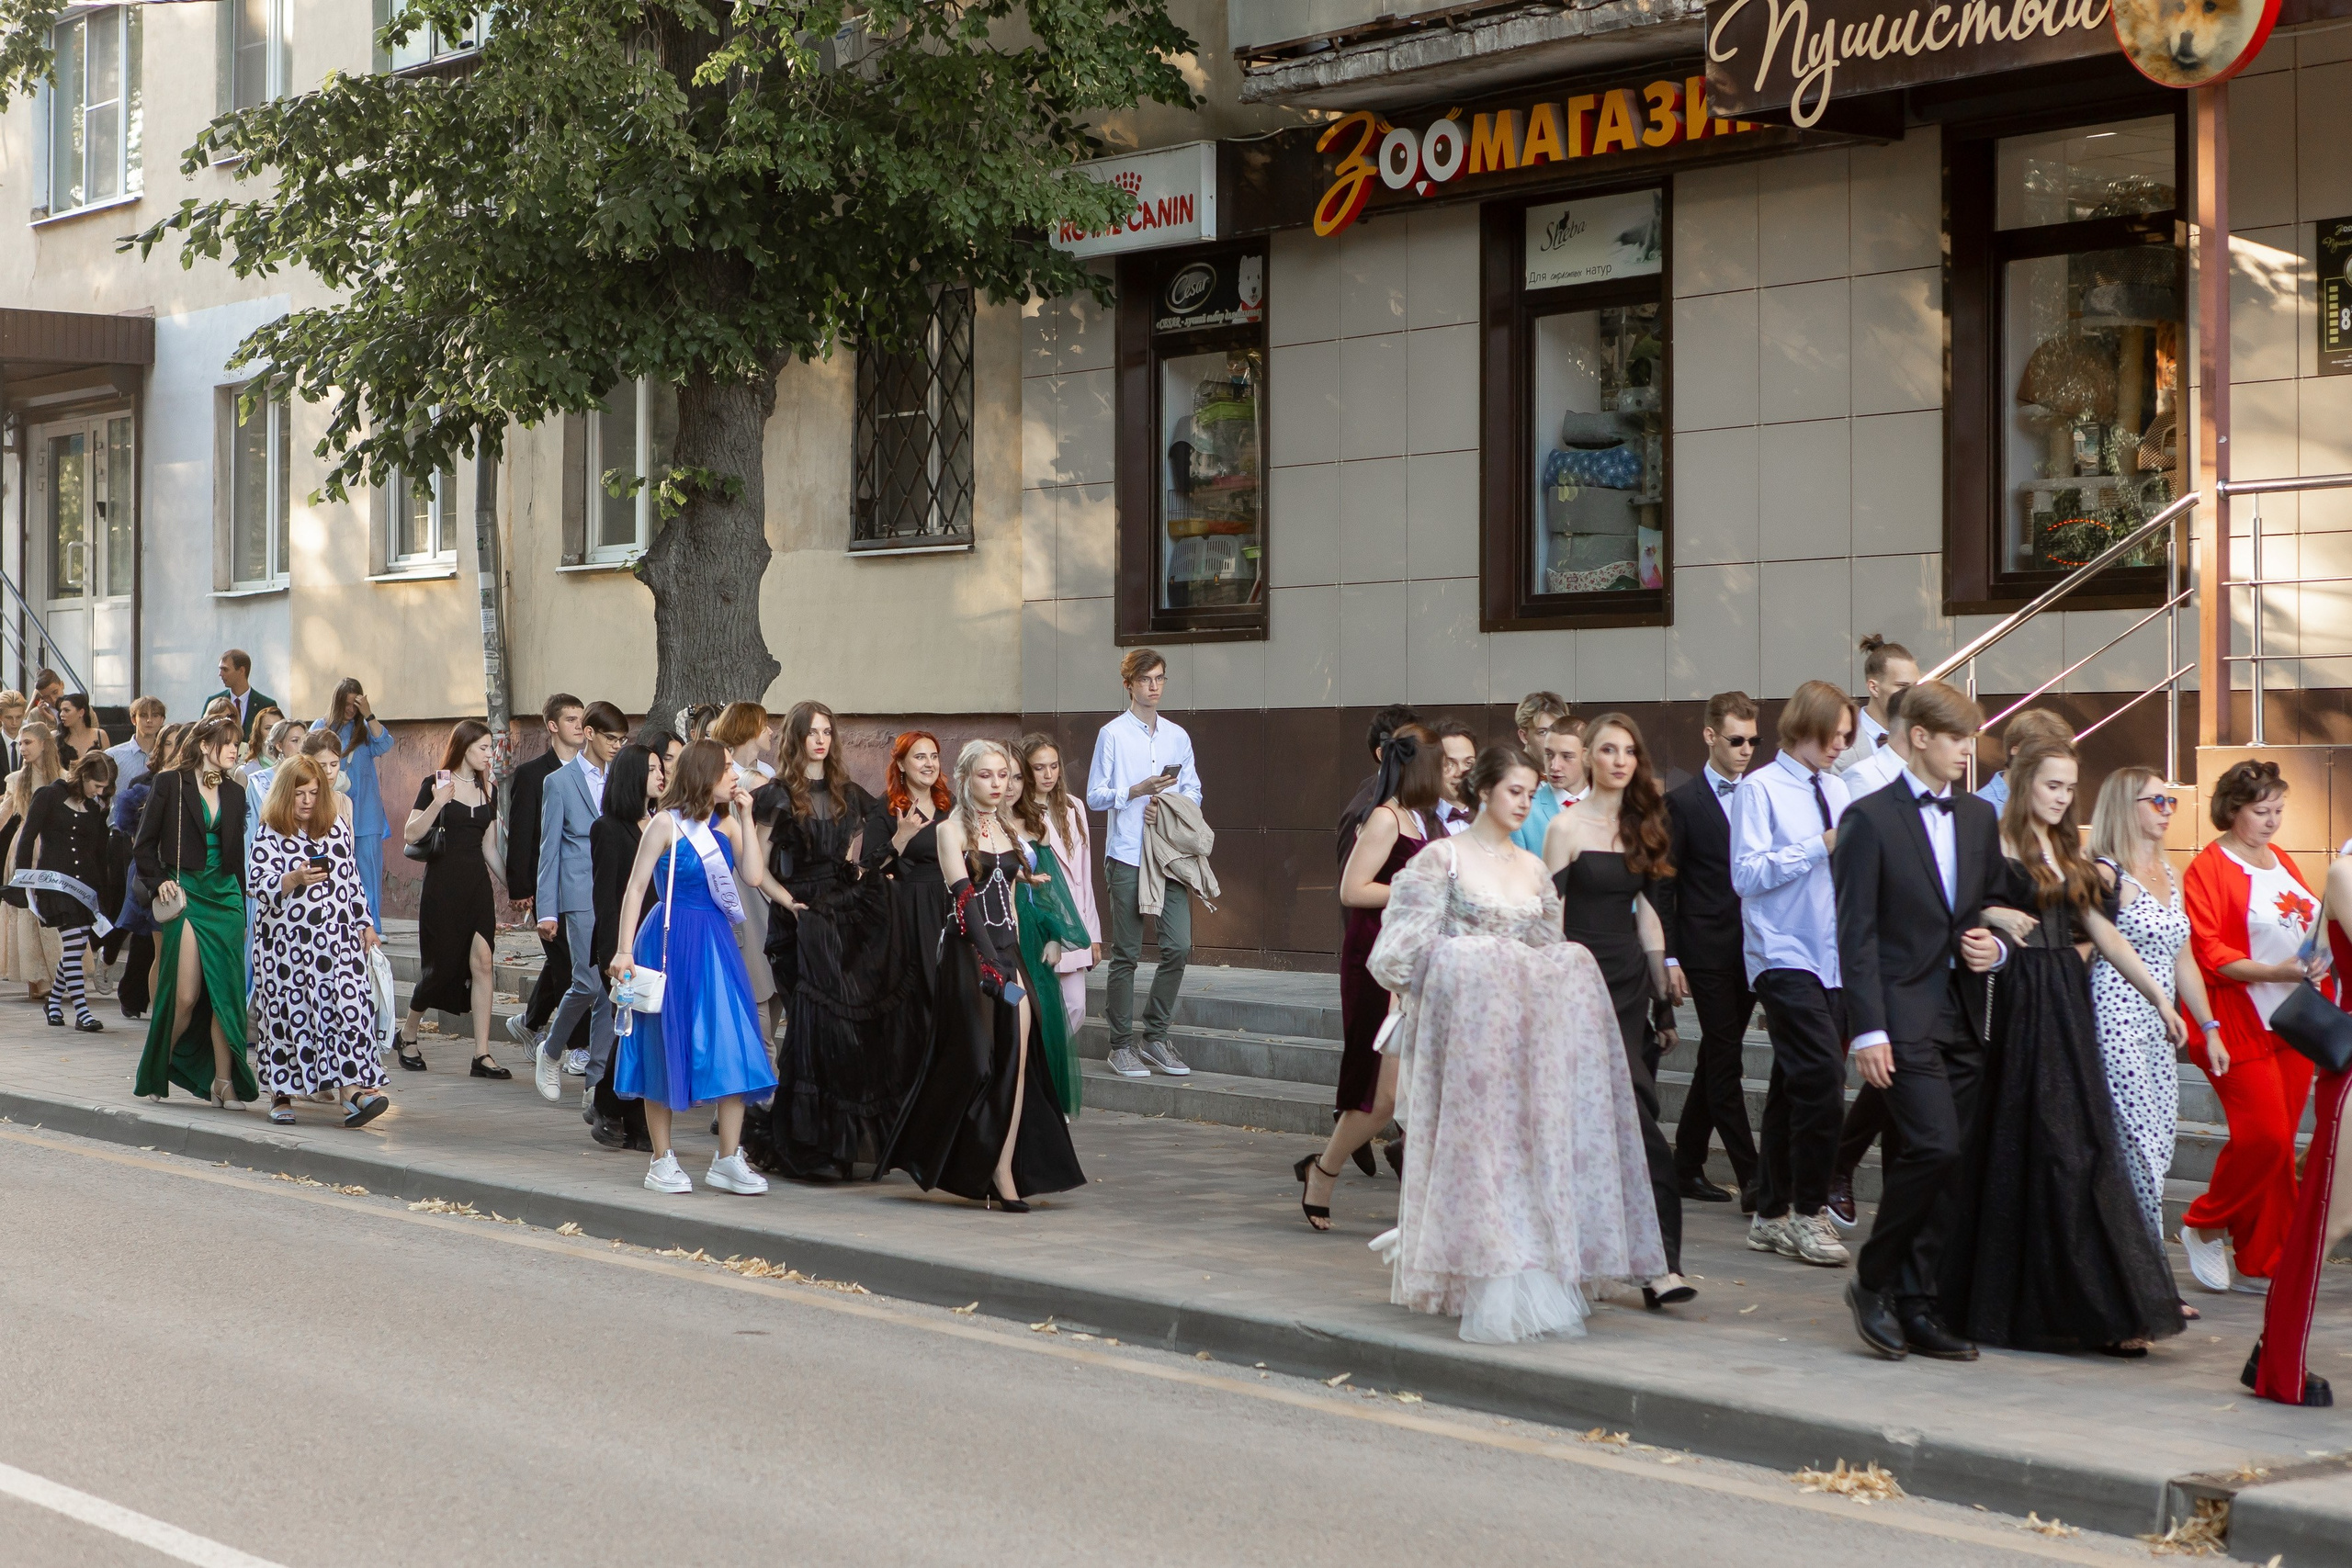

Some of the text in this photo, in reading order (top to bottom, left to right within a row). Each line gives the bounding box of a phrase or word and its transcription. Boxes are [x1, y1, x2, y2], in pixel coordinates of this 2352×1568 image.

[1314, 75, 1772, 237] ЗООМАГАЗИ
[1127, 193, 1193, 231] CANIN
[1540, 220, 1587, 252] Sheba
[1171, 274, 1211, 305] Cesar
[1529, 271, 1547, 285] Для
[1586, 264, 1612, 277] натур
